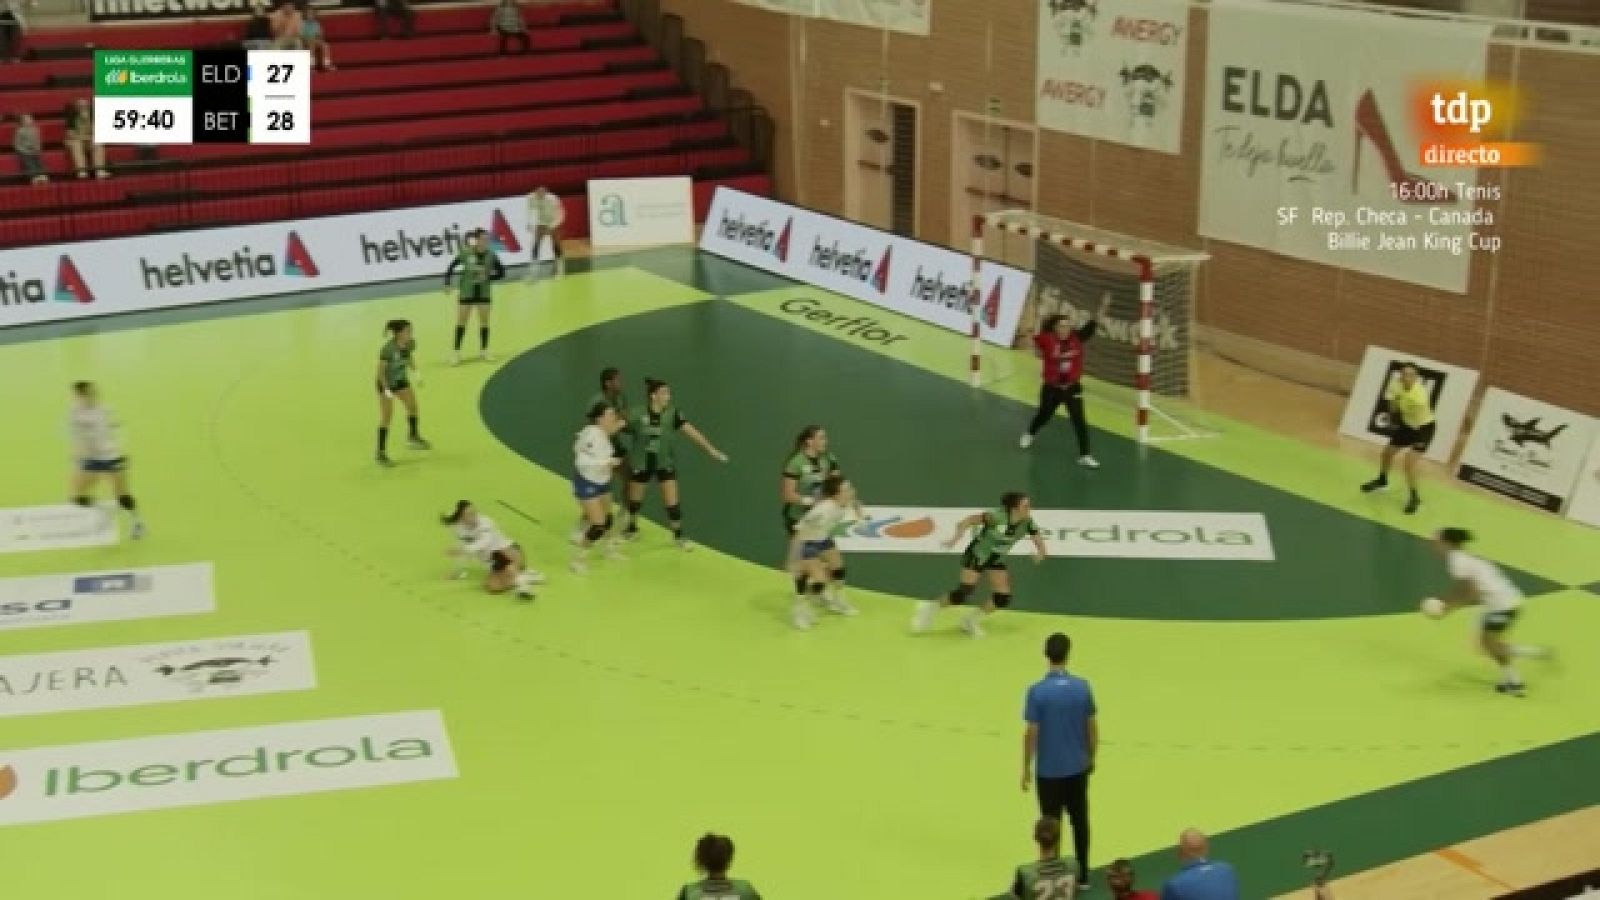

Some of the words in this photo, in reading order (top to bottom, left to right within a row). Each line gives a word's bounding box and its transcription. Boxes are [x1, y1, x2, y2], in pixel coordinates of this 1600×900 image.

[1222, 66, 1334, 128] ELDA
[716, 207, 775, 251] helvetia
[139, 245, 275, 290] helvetia
[808, 232, 874, 282] helvetia
[779, 297, 910, 346] Gerflor
[43, 735, 434, 797] Iberdrola
